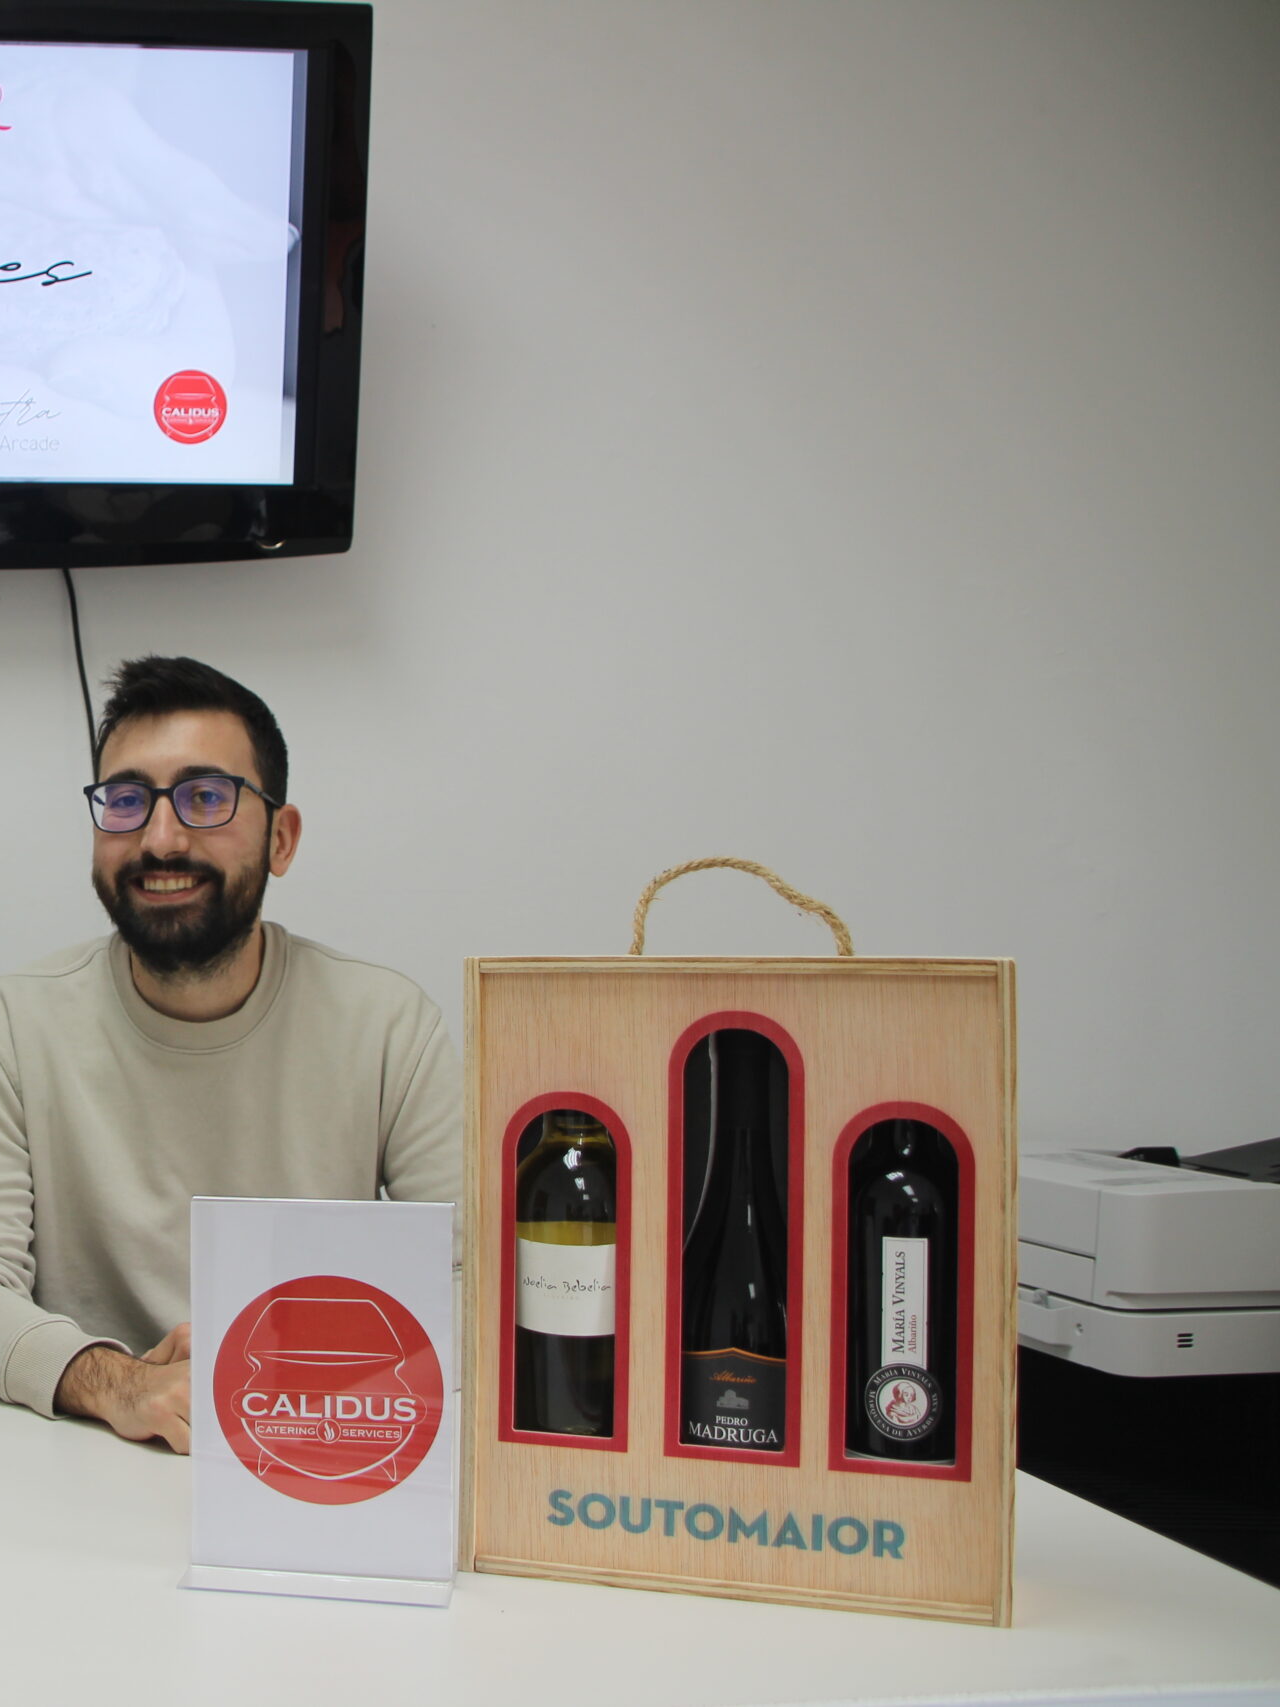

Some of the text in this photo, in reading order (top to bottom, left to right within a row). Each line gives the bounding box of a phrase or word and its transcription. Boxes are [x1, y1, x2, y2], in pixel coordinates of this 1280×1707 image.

[161, 407, 220, 417] CALIDUS
[523, 1276, 612, 1293] Noelia Bebelia
[892, 1251, 905, 1353] MARÍA VINYALS
[241, 1391, 417, 1422] CALIDUS
[715, 1415, 749, 1427] PEDRO
[256, 1425, 401, 1439] CATERING SERVICES
[689, 1420, 779, 1444] MADRUGA
[547, 1489, 906, 1560] SOUTOMAIOR
